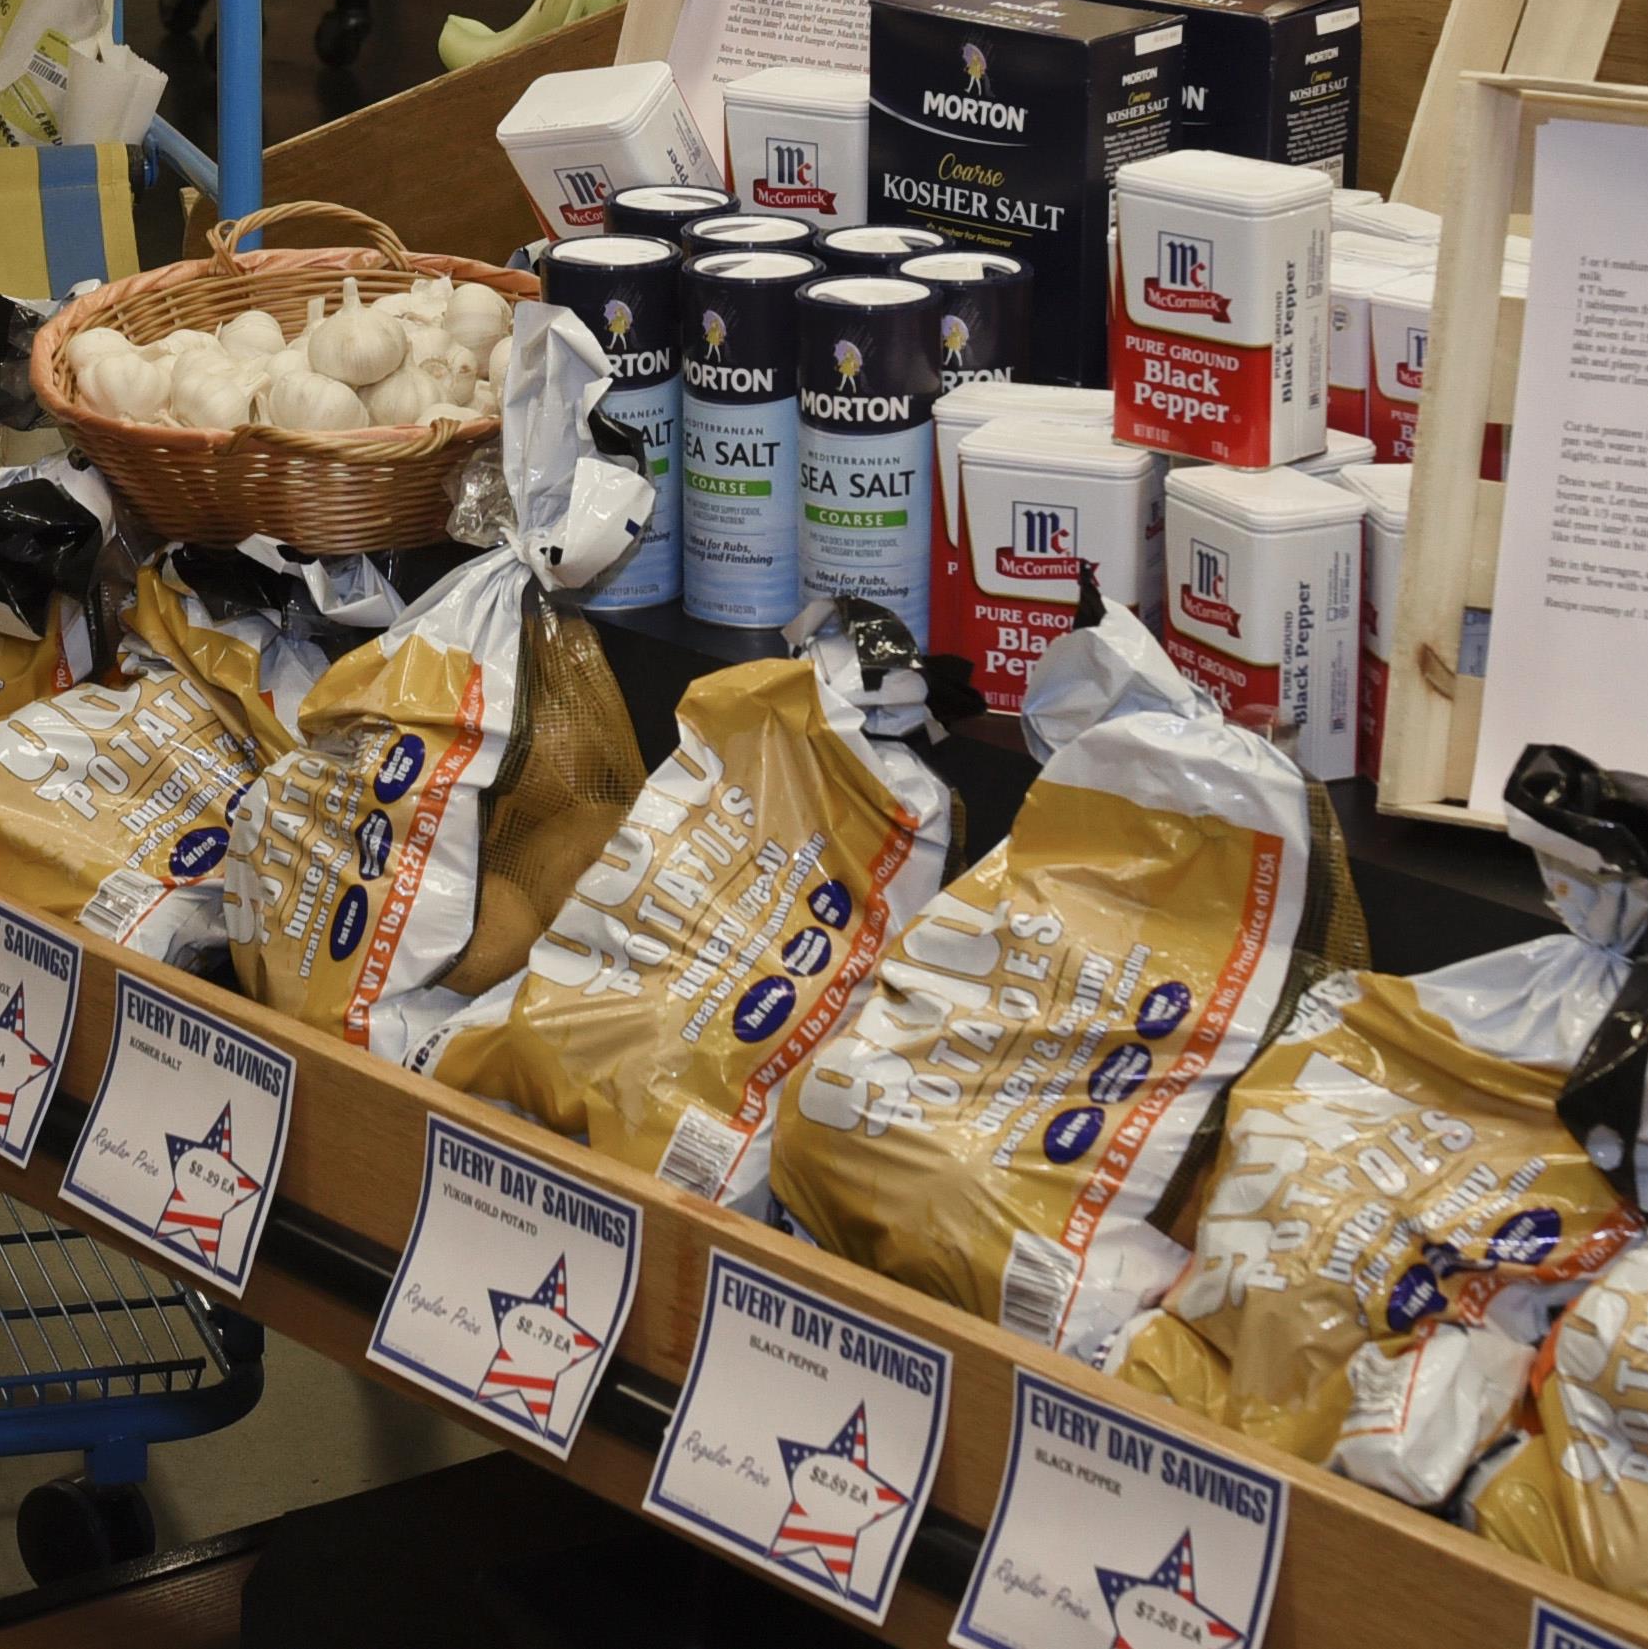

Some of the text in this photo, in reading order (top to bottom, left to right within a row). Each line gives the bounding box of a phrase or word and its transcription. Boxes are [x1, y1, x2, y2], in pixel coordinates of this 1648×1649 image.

[1305, 47, 1339, 65] MORTON
[1122, 67, 1158, 87] MORTON
[922, 90, 1025, 133] MORTON
[1107, 97, 1170, 124] KOSHER SALT
[938, 153, 1005, 188] Coarse
[757, 188, 827, 206] McCormick
[883, 173, 1065, 233] KOSHER SALT
[1147, 287, 1221, 312] McCormick
[1125, 336, 1239, 372] PURE GROUND
[1144, 359, 1220, 396] Black
[802, 387, 909, 422] MORTON
[1133, 381, 1230, 424] Pepper
[715, 441, 781, 467] SALT
[808, 450, 901, 465] MEDITERRANEAN
[691, 475, 747, 495] COARSE
[802, 463, 915, 498] SEA SALT
[819, 510, 884, 526] COARSE
[725, 552, 773, 567] Finishing
[859, 576, 888, 587] Rubs,
[1294, 580, 1314, 725] Black Pepper
[119, 760, 201, 835] buttery
[1256, 853, 1276, 885] USA
[283, 838, 334, 940] buttery
[603, 785, 757, 997] POTATOES
[379, 901, 406, 935] lbs
[4, 923, 70, 982] SAVINGS
[374, 938, 391, 956] 5
[360, 959, 385, 992] WT
[127, 991, 283, 1098] EVERY DAY SAVINGS
[129, 1036, 181, 1073] KOSHER SALT
[756, 1054, 791, 1086] WT
[788, 1039, 803, 1056] 5
[800, 1011, 832, 1043] lbs
[221, 1175, 235, 1195] EA
[439, 1136, 625, 1249] EVERY DAY SAVINGS
[443, 1183, 538, 1236] YUKON GOLD POTATO
[553, 1332, 571, 1354] EA
[722, 1274, 934, 1396] EVERY DAY SAVINGS
[750, 1334, 829, 1381] BLACK PEPPER
[1030, 1393, 1268, 1525] EVERY DAY SAVINGS
[1035, 1447, 1122, 1498] BLACK PEPPER
